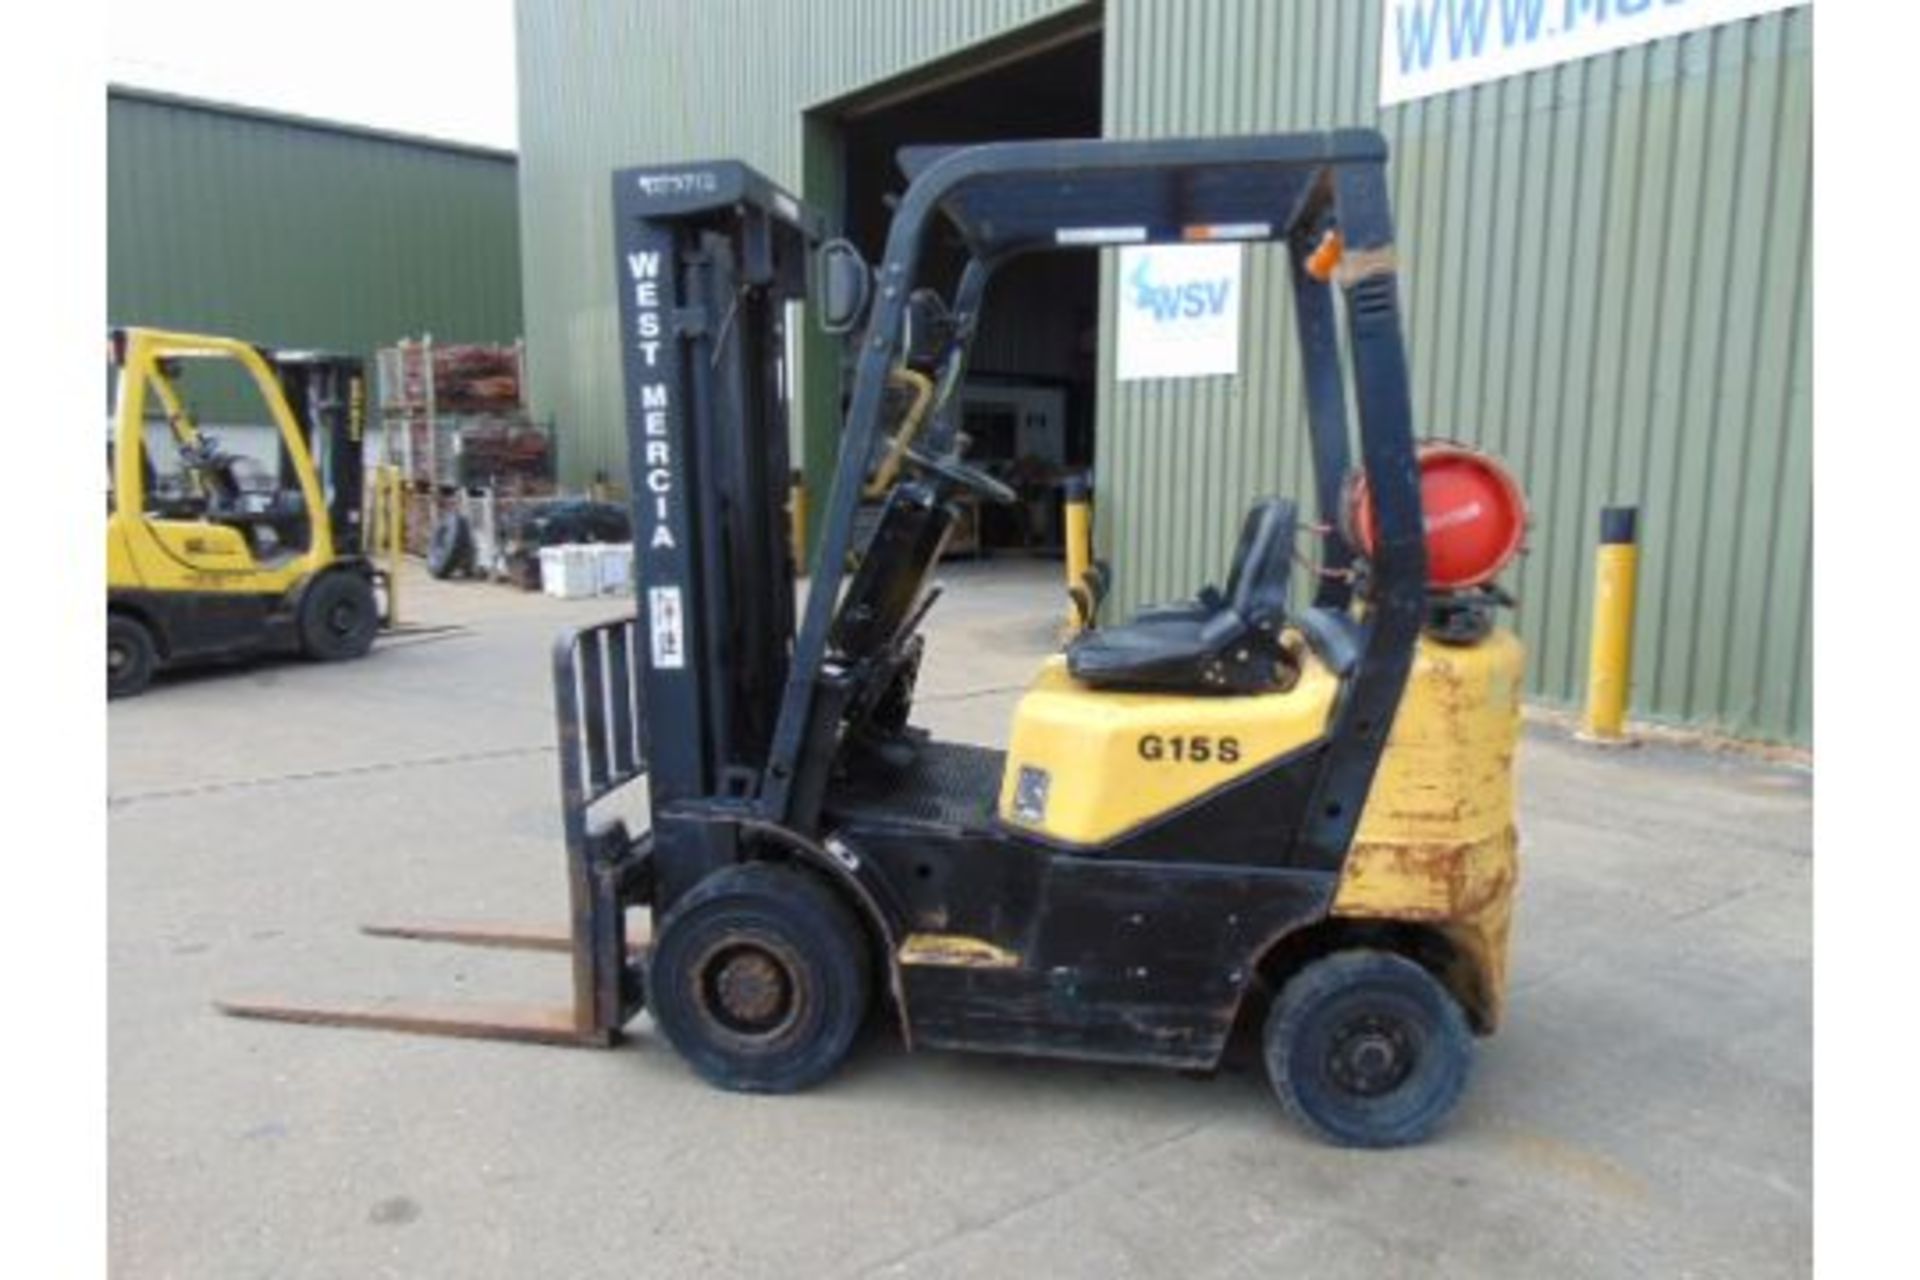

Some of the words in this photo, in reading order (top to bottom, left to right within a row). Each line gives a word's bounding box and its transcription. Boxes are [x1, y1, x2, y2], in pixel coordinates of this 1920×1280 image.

[1396, 0, 1692, 74] WWW.
[628, 251, 661, 366] WEST
[642, 384, 675, 548] MERCIA
